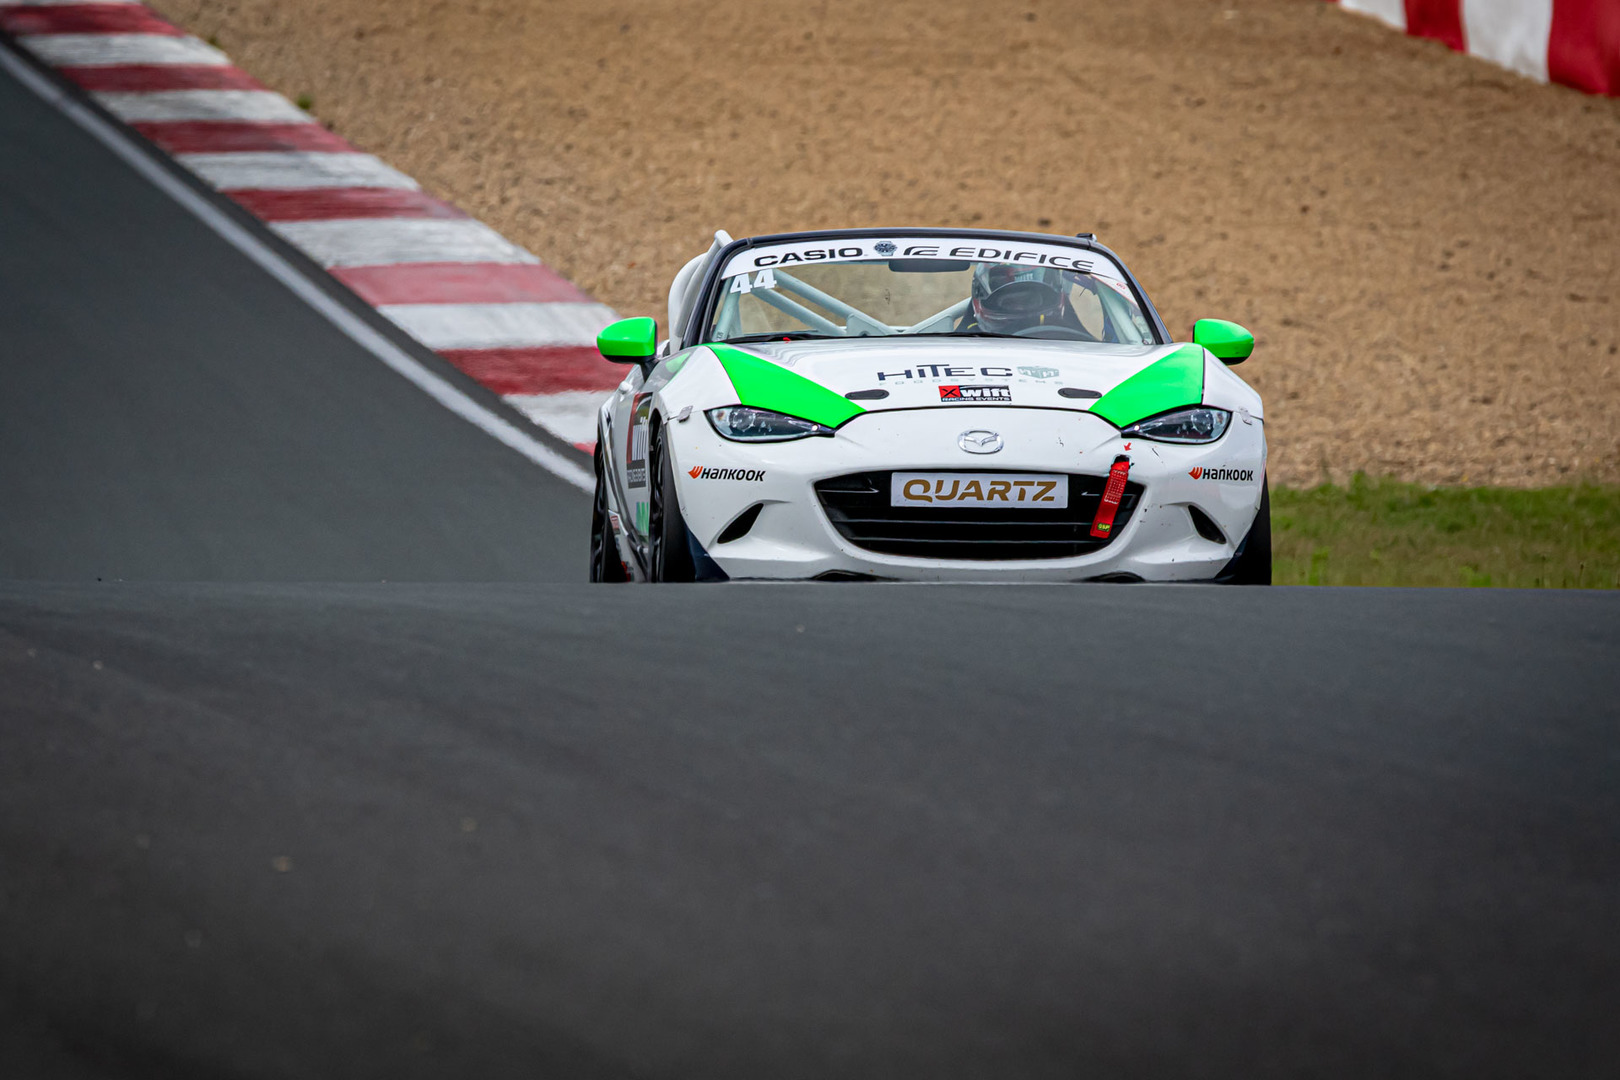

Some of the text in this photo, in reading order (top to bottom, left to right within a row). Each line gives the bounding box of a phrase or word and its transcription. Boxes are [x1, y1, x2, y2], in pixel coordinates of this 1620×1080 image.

[754, 247, 1095, 272] CASIO EDIFICE
[730, 269, 778, 294] 44
[902, 478, 1058, 503] QUARTZ
